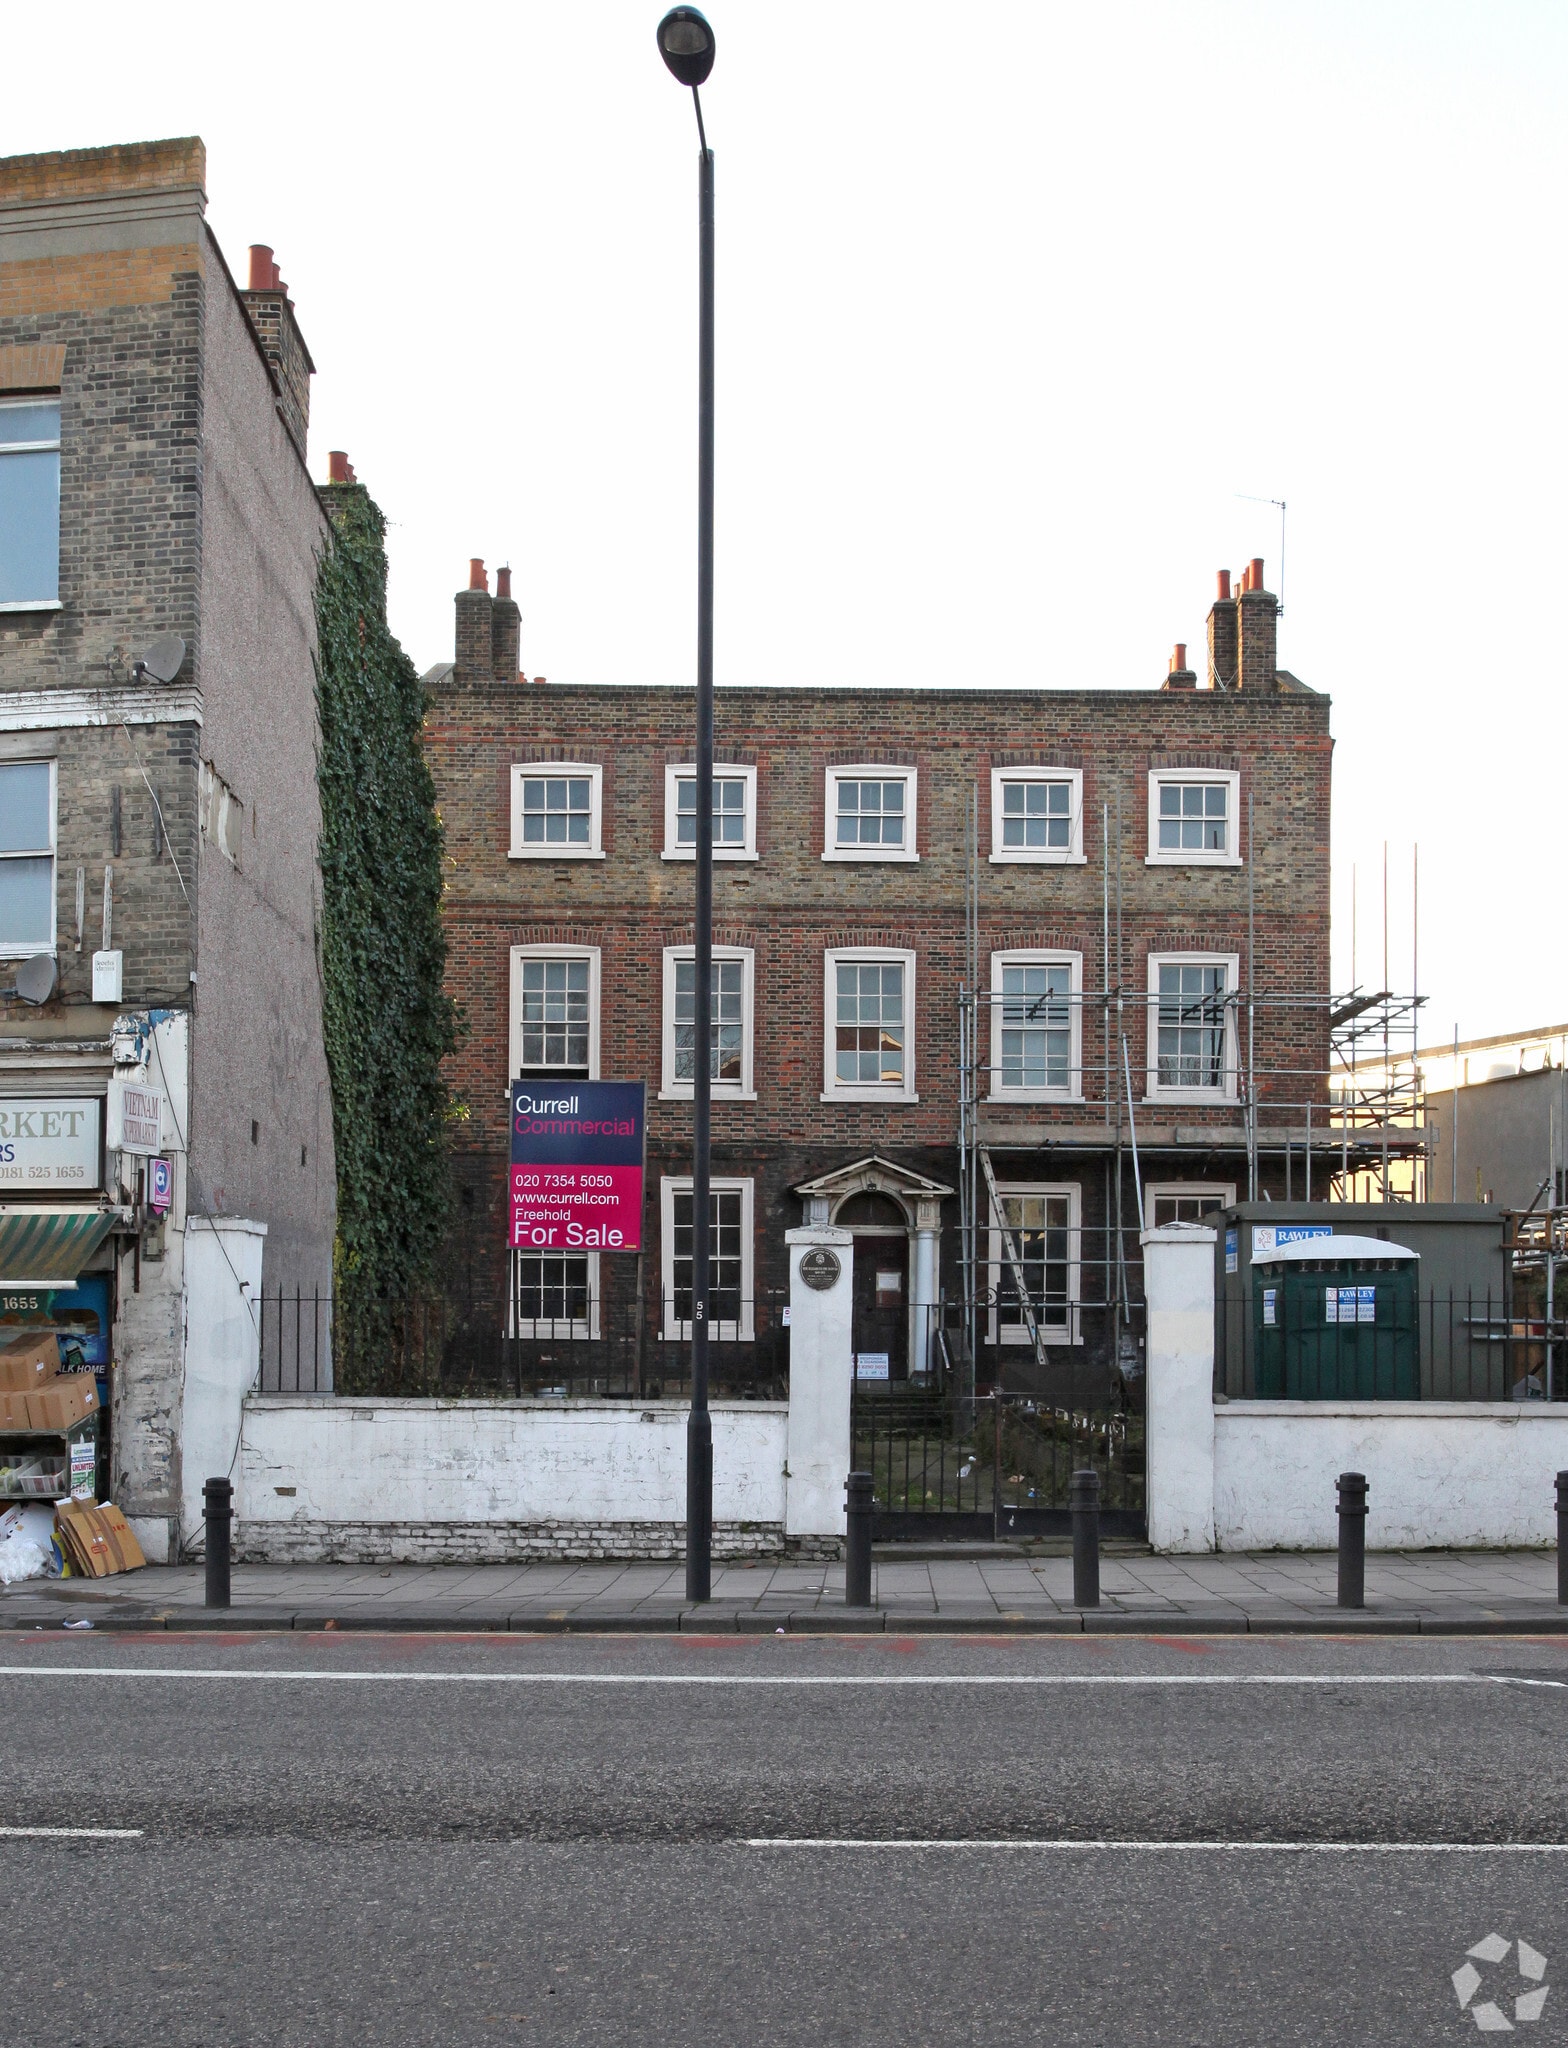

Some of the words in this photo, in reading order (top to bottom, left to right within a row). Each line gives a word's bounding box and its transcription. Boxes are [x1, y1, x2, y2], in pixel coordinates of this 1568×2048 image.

[124, 1091, 158, 1120] VIETNAM
[516, 1095, 579, 1114] Currell
[515, 1115, 635, 1136] Commercial
[28, 1166, 51, 1179] 525
[55, 1166, 85, 1179] 1655
[515, 1174, 540, 1187] 020
[544, 1174, 576, 1187] 7354
[580, 1175, 613, 1187] 5050
[513, 1192, 619, 1205] www.currell.com
[515, 1208, 571, 1221] Freehold
[514, 1221, 558, 1245] For
[565, 1222, 624, 1246] Sale
[1339, 1290, 1374, 1298] RAWLEY
[2, 1296, 39, 1310] 1655
[58, 1365, 75, 1373] LK
[77, 1365, 105, 1374] HOME
